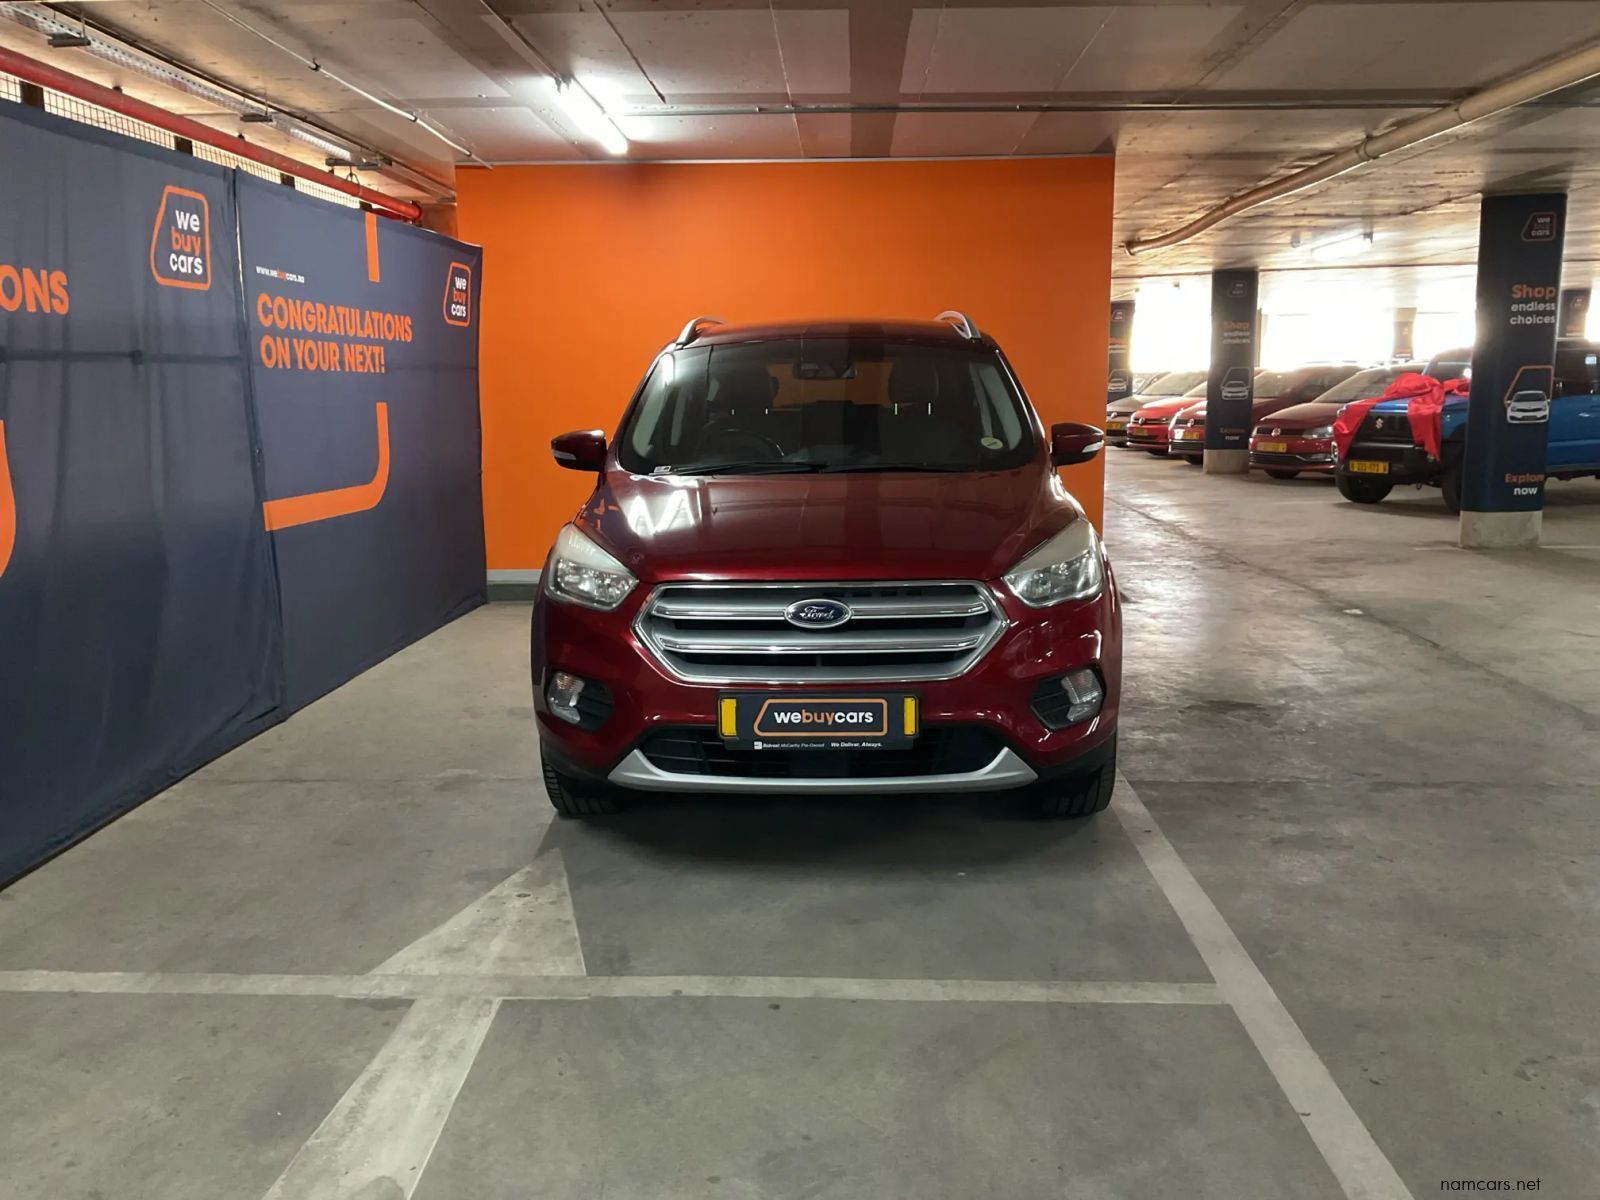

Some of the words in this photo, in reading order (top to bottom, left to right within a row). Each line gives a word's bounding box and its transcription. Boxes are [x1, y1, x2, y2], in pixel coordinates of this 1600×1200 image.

[175, 210, 200, 232] we
[171, 225, 201, 257] buy
[169, 253, 203, 275] cars
[454, 276, 467, 290] we
[1511, 284, 1556, 300] Shop
[451, 303, 467, 317] cars
[1510, 301, 1556, 312] endless
[257, 293, 413, 342] CONGRATULATIONS
[1509, 314, 1556, 325] choices
[260, 334, 291, 369] ON
[293, 338, 341, 371] YOUR
[343, 343, 385, 373] NEXT!
[1513, 487, 1538, 496] now
[800, 605, 835, 619] Ford
[774, 709, 874, 726] webuycars
